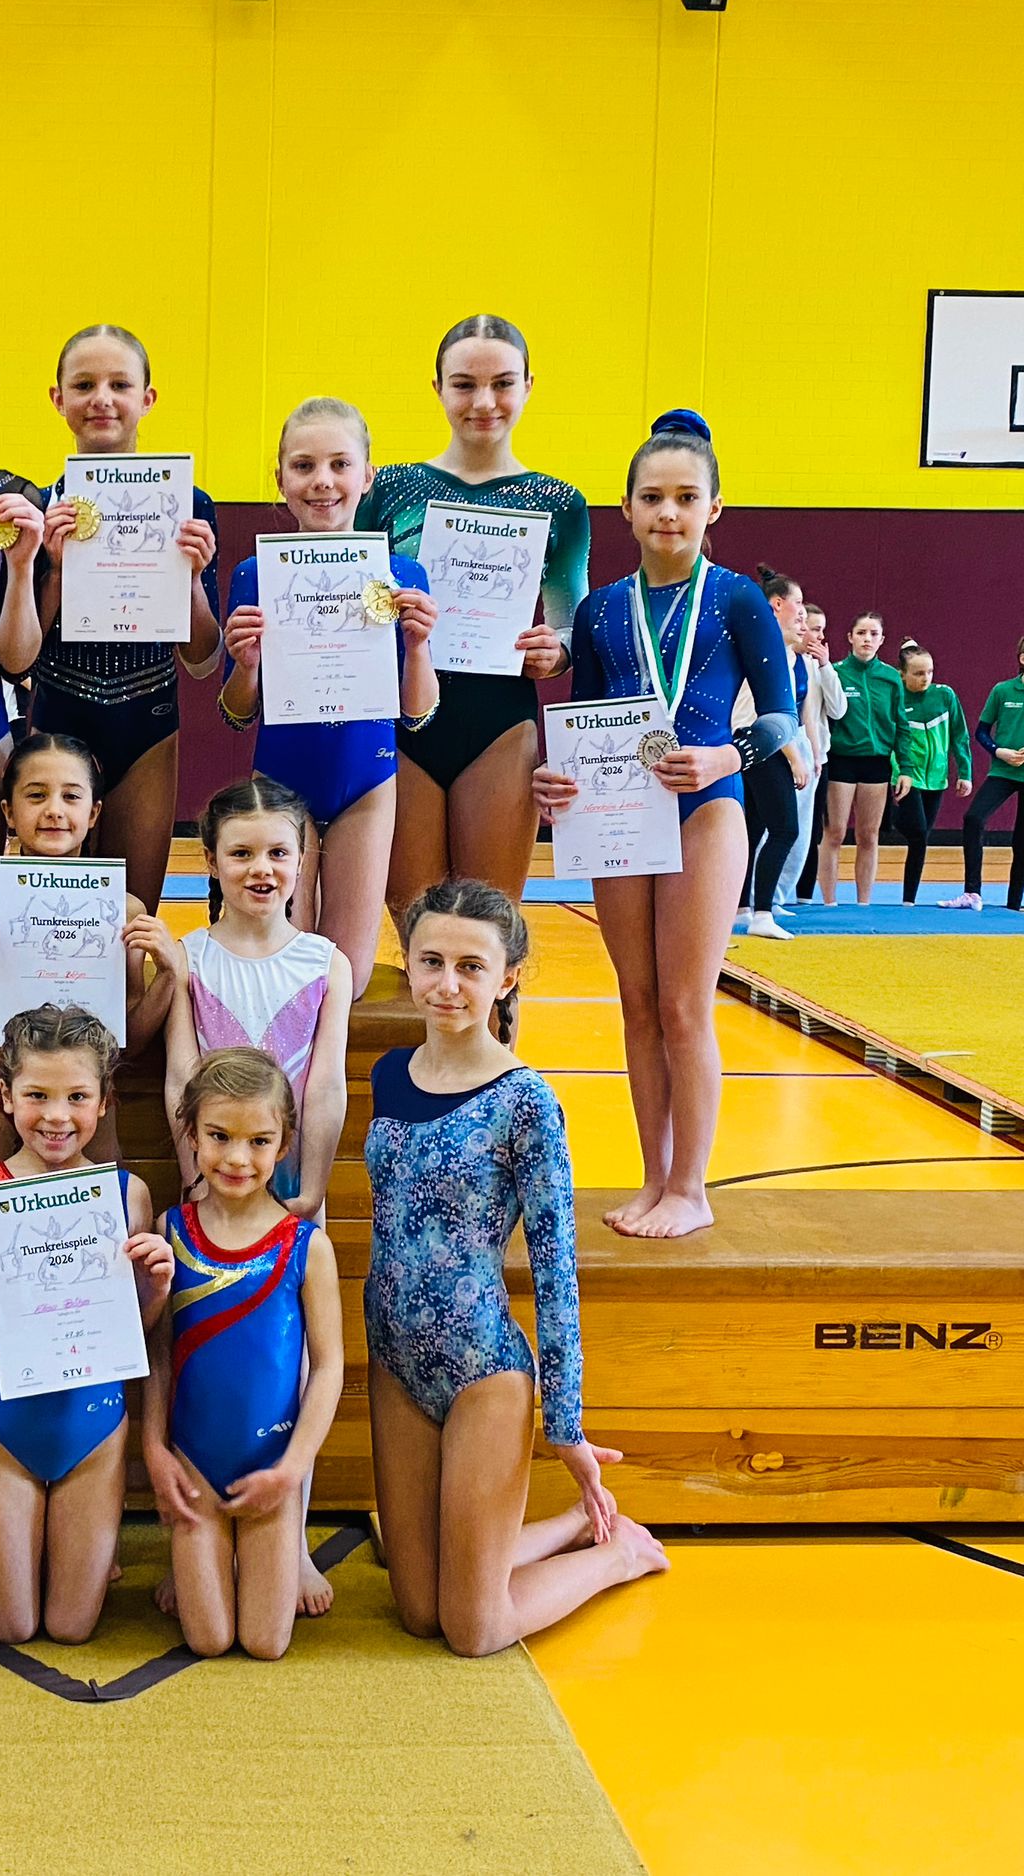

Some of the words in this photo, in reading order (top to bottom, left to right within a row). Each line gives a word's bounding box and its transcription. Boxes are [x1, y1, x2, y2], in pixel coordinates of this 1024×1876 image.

[95, 467, 161, 484] Urkunde
[117, 525, 139, 535] 2026
[455, 518, 518, 538] Urkunde
[290, 548, 358, 564] Urkunde
[450, 557, 512, 573] Turnkreisspiele
[468, 572, 489, 582] 2026
[294, 591, 362, 603] Turnkreisspiele
[317, 605, 339, 615] 2026
[319, 705, 337, 713] STV
[575, 711, 642, 730] Urkunde
[601, 766, 623, 775] 2026
[604, 859, 621, 867] STV
[29, 873, 100, 889] Urkunde
[30, 916, 100, 929] Turnkreisspiele
[54, 930, 77, 940] 2026
[10, 1187, 90, 1213] Urkunde
[20, 1235, 98, 1256] Turnkreisspiele
[49, 1253, 74, 1266] 2026
[62, 1367, 82, 1378] STV
